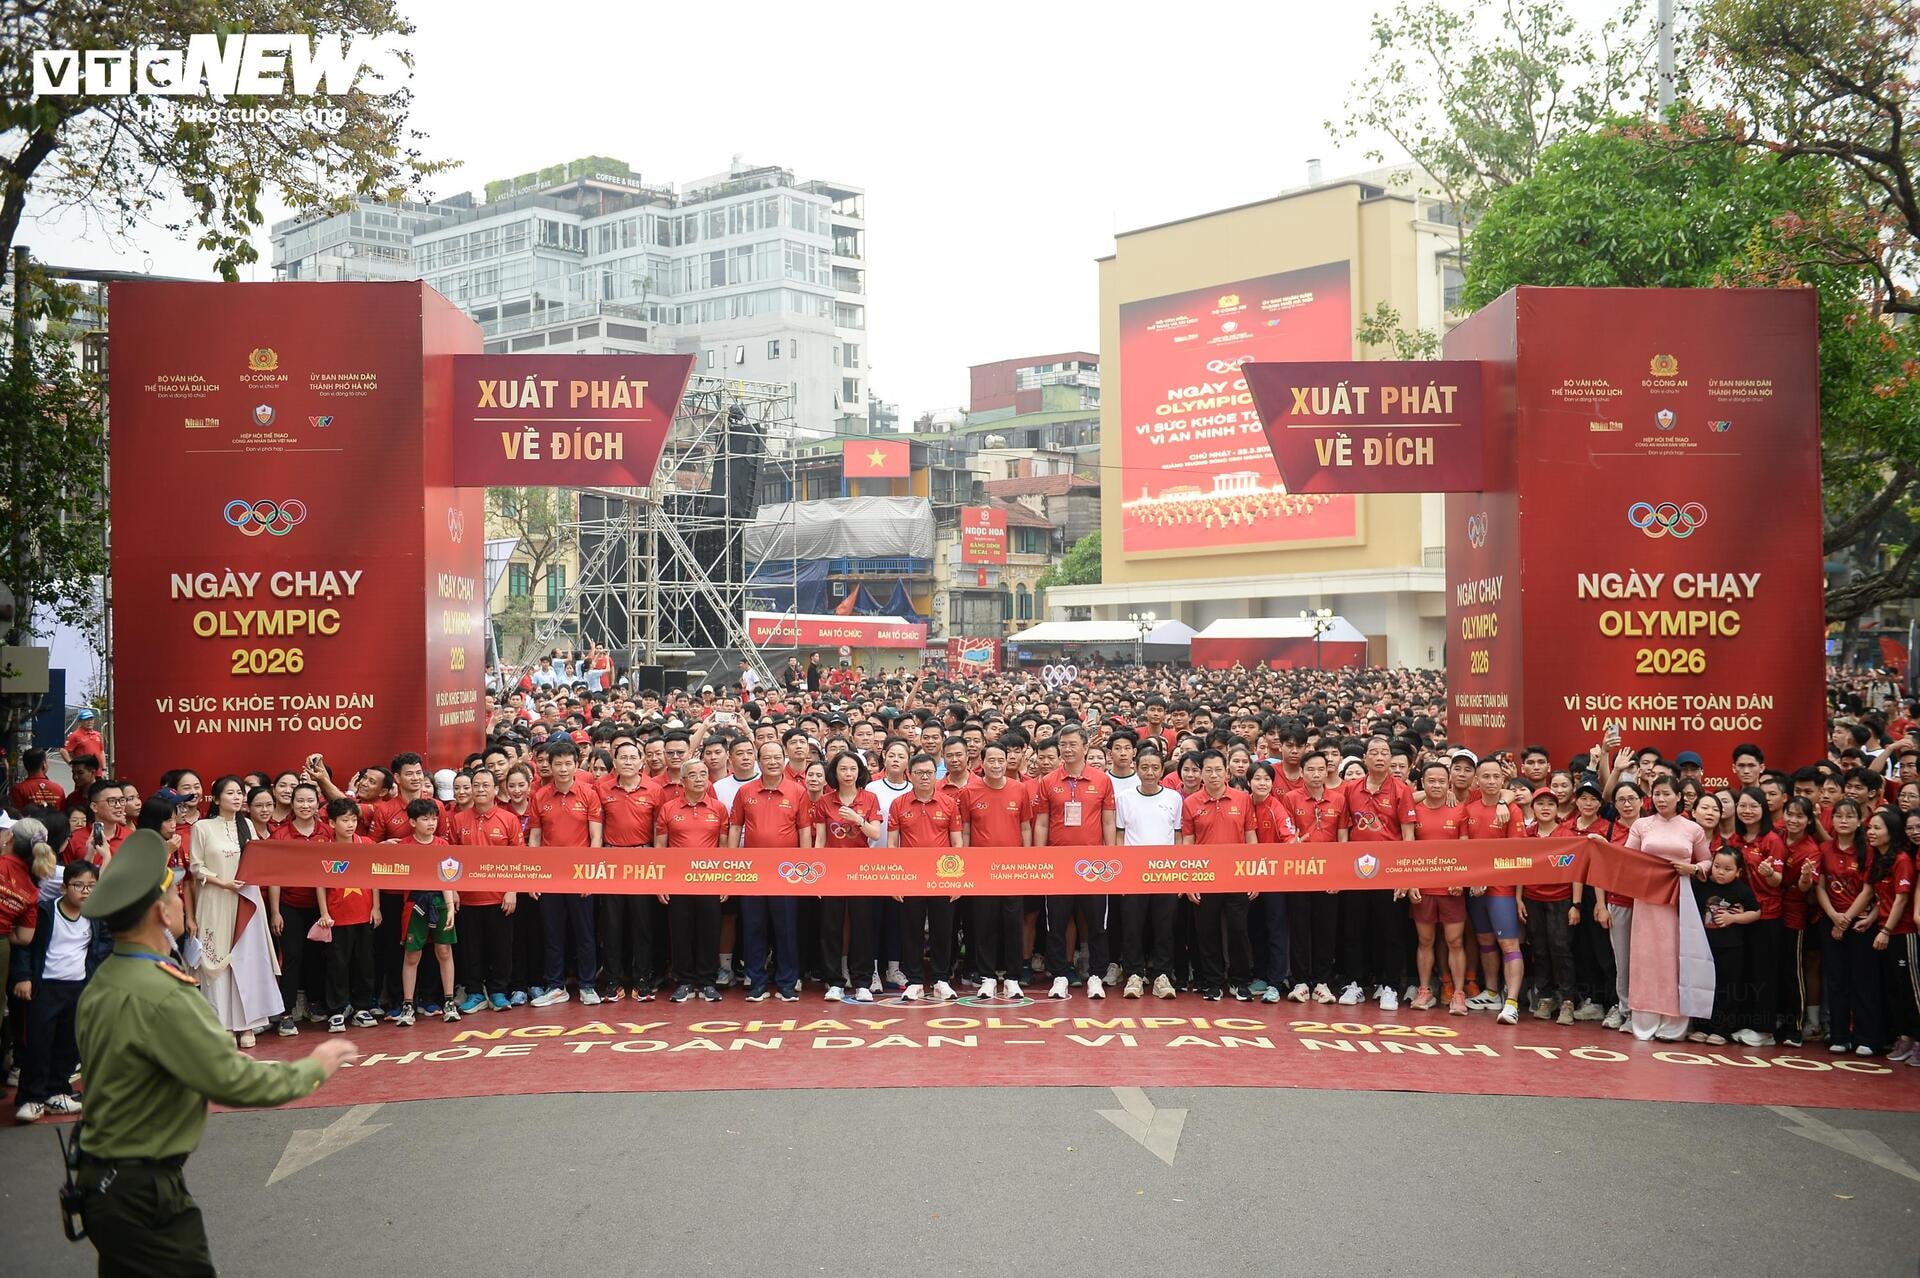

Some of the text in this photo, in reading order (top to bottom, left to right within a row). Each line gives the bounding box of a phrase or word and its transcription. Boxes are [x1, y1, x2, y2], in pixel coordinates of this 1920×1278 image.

[596, 172, 620, 184] COFFEE
[240, 374, 250, 383] BỘ
[252, 374, 276, 382] CÔNG
[309, 382, 333, 390] THÀNH
[364, 382, 377, 390] NỘI
[1654, 379, 1676, 387] CÔNG
[478, 374, 648, 408] XUẤT PHÁT
[1168, 381, 1228, 400] NGÀY
[1290, 380, 1458, 415] XUẤT PHÁT
[1156, 392, 1253, 416] OLYMPIC
[308, 416, 333, 427] VTV
[1136, 422, 1150, 436] VÌ
[1708, 421, 1731, 432] VTV
[501, 425, 623, 460] VỀ ĐÍCH
[1150, 433, 1164, 445] VÌ
[1168, 431, 1190, 443] AN
[1195, 426, 1234, 440] NINH
[1314, 432, 1352, 466] VỀ
[1363, 433, 1434, 466] ĐÍCH
[965, 527, 1004, 537] NGỌC HOA
[171, 568, 363, 600] NGÀY CHẠY
[438, 570, 475, 605] NGÀY CHẠY
[1457, 576, 1502, 607] NGÀY CHẠY
[1578, 568, 1761, 602] NGÀY CHẠY
[193, 608, 341, 637] OLYMPIC
[443, 610, 471, 635] OLYMPIC
[1462, 612, 1497, 640] OLYMPIC
[1599, 610, 1741, 636] OLYMPIC
[819, 629, 834, 637] BAN
[844, 627, 863, 638] CHỨC
[878, 630, 892, 640] BAN
[901, 629, 919, 640] CHỨC
[231, 648, 304, 674] 2026
[450, 648, 464, 671] 2026
[1471, 650, 1488, 674] 2026
[1636, 648, 1706, 674] 2026
[156, 692, 374, 713] VÌ SỨC KHỎE TOÀN DÂN
[1564, 692, 1773, 710] VÌ SỨC KHỎE TOÀN DÂN
[174, 712, 362, 733] VÌ AN NINH TỔ QUỐC
[1581, 713, 1762, 731] VÌ AN NINH TỔ QUỐC
[1702, 778, 1729, 787] .2026
[321, 860, 350, 873] VTV
[372, 863, 410, 873] Nhân Dân
[480, 864, 497, 872] HIỆP
[498, 864, 511, 872] HỘI
[513, 863, 525, 872] THỂ
[691, 860, 752, 872] NGÀY CHẠY
[860, 864, 870, 872] BỘ
[991, 862, 1001, 871] ỦY
[1148, 859, 1210, 870] NGÀY CHẠY
[1235, 857, 1326, 876] XUẤT PHÁT
[1494, 857, 1532, 868] Nhân Dân
[1548, 854, 1575, 867] VTV
[573, 860, 666, 880] XUẤT PHÁT
[685, 872, 758, 882] OLYMPIC 2026
[847, 872, 858, 881] THỂ
[879, 872, 889, 880] VÀ
[902, 873, 917, 882] LỊCH
[990, 871, 1054, 880] THÀNH PHỐ HÀ NỘI
[1142, 871, 1215, 882] OLYMPIC 2026
[927, 881, 938, 889] BỘ
[939, 880, 961, 889] CÔNG
[450, 1017, 1459, 1042] NGÀY CHẠY OLYMPIC 2026
[563, 1037, 783, 1054] TOÀN
[812, 1033, 978, 1049] DÂN
[1065, 1032, 1139, 1048] VÌ
[1166, 1035, 1276, 1049] AN
[1300, 1038, 1500, 1057] NINH
[1513, 1044, 1630, 1062] TỔ
[1652, 1050, 1893, 1075] QUỐC
